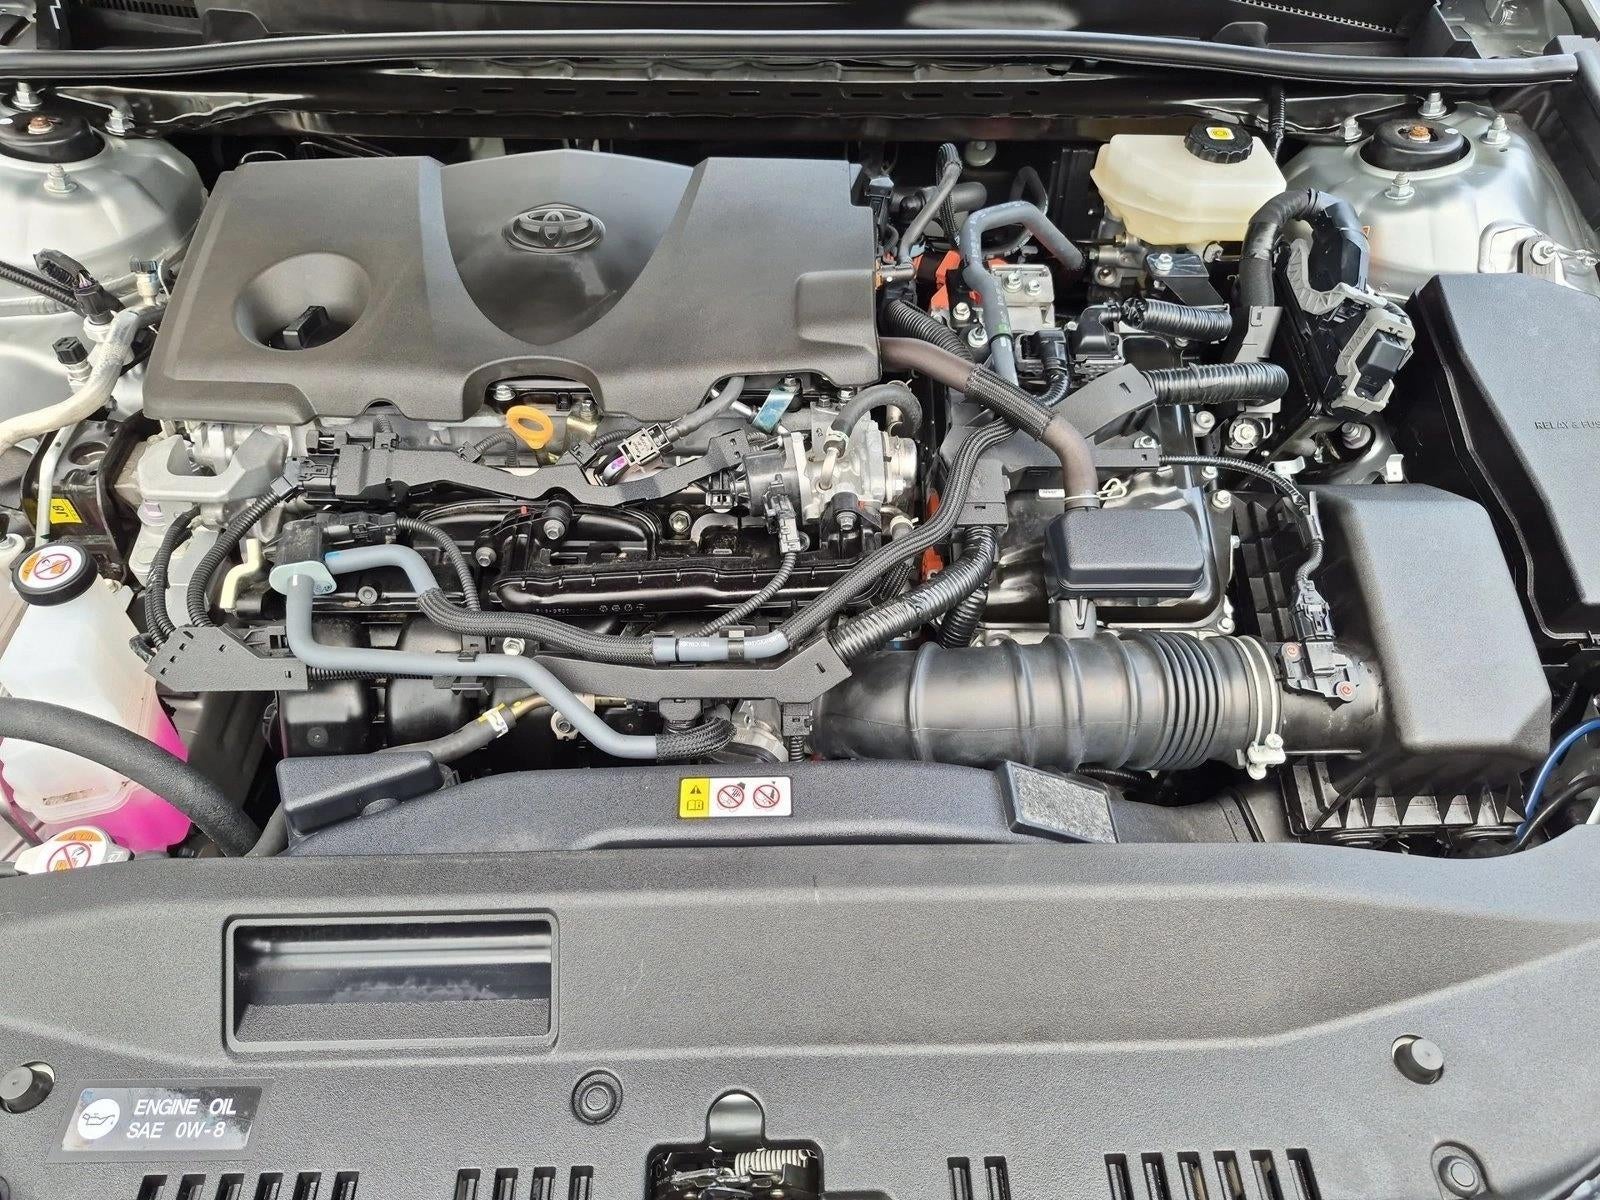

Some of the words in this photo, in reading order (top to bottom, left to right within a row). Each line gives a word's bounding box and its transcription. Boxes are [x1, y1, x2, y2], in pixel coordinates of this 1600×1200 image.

[1534, 421, 1569, 430] RELAY
[1571, 421, 1579, 429] &
[133, 1098, 200, 1115] ENGINE
[209, 1098, 236, 1115] OIL
[126, 1121, 165, 1139] SAE
[175, 1121, 226, 1138] 0W-8
